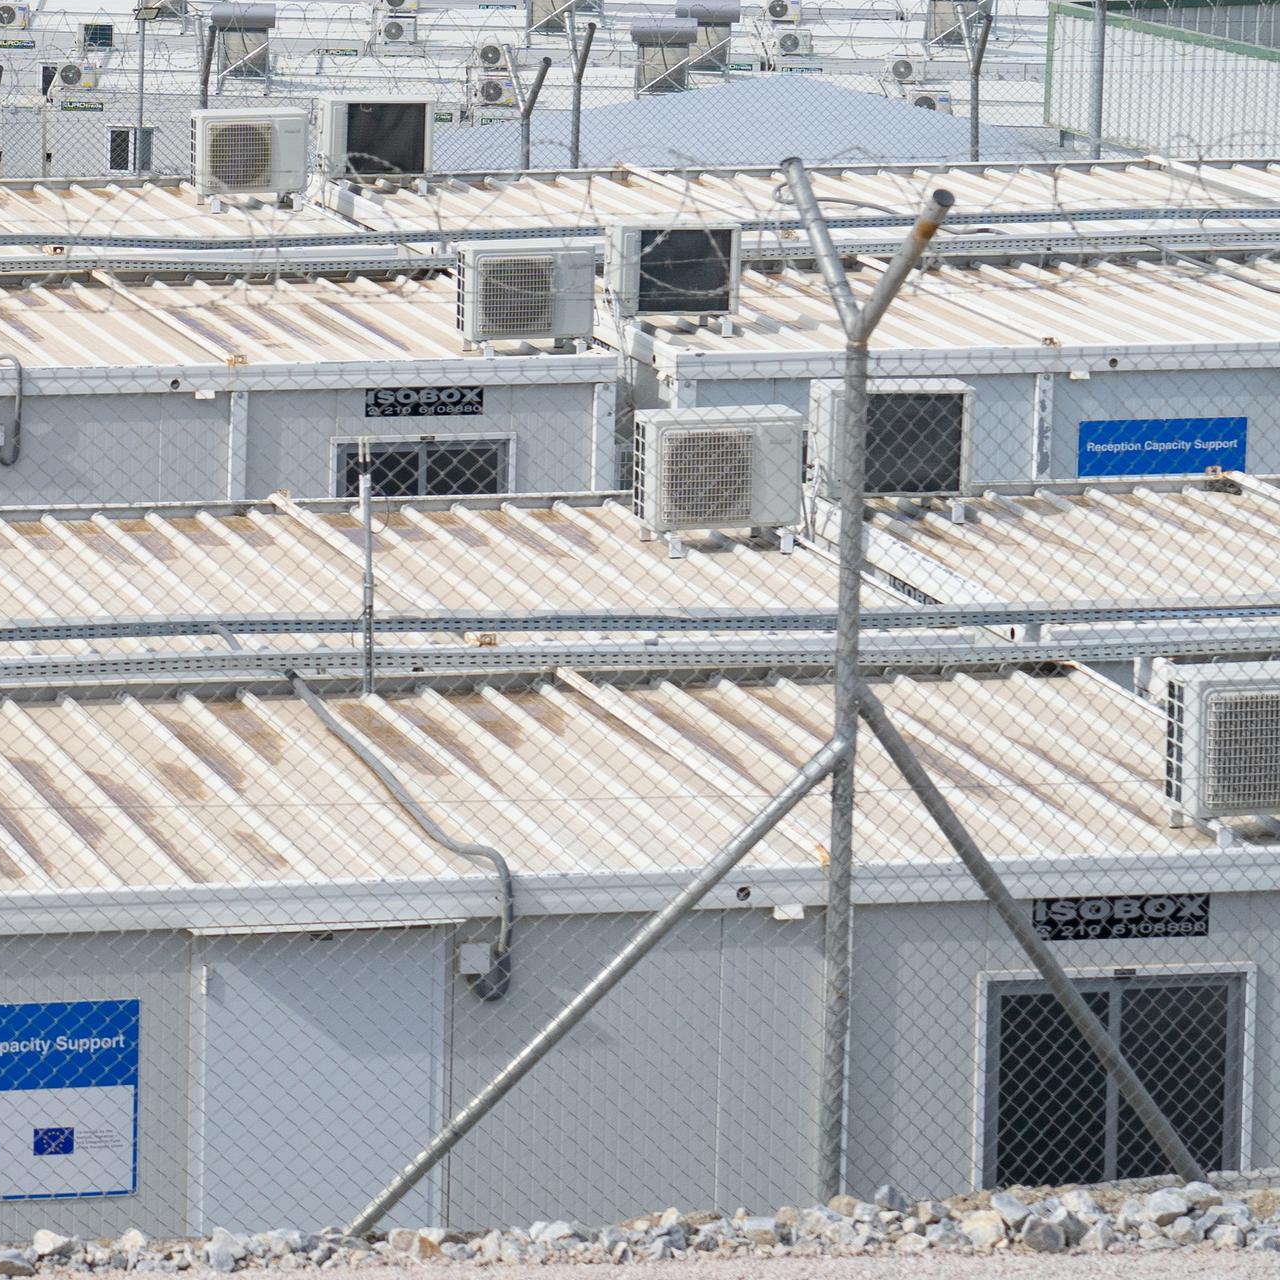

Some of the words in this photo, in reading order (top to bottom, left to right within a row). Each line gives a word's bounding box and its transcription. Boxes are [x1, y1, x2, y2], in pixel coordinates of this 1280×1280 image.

[366, 388, 481, 404] ISOBOX
[385, 406, 412, 415] 210
[1086, 442, 1142, 453] Reception
[1144, 440, 1191, 452] Capacity
[1194, 439, 1238, 451] Support
[1036, 895, 1207, 921] ISOBOX
[1061, 924, 1102, 936] 210
[1113, 921, 1206, 935] 6108880
[55, 1034, 126, 1052] Support
